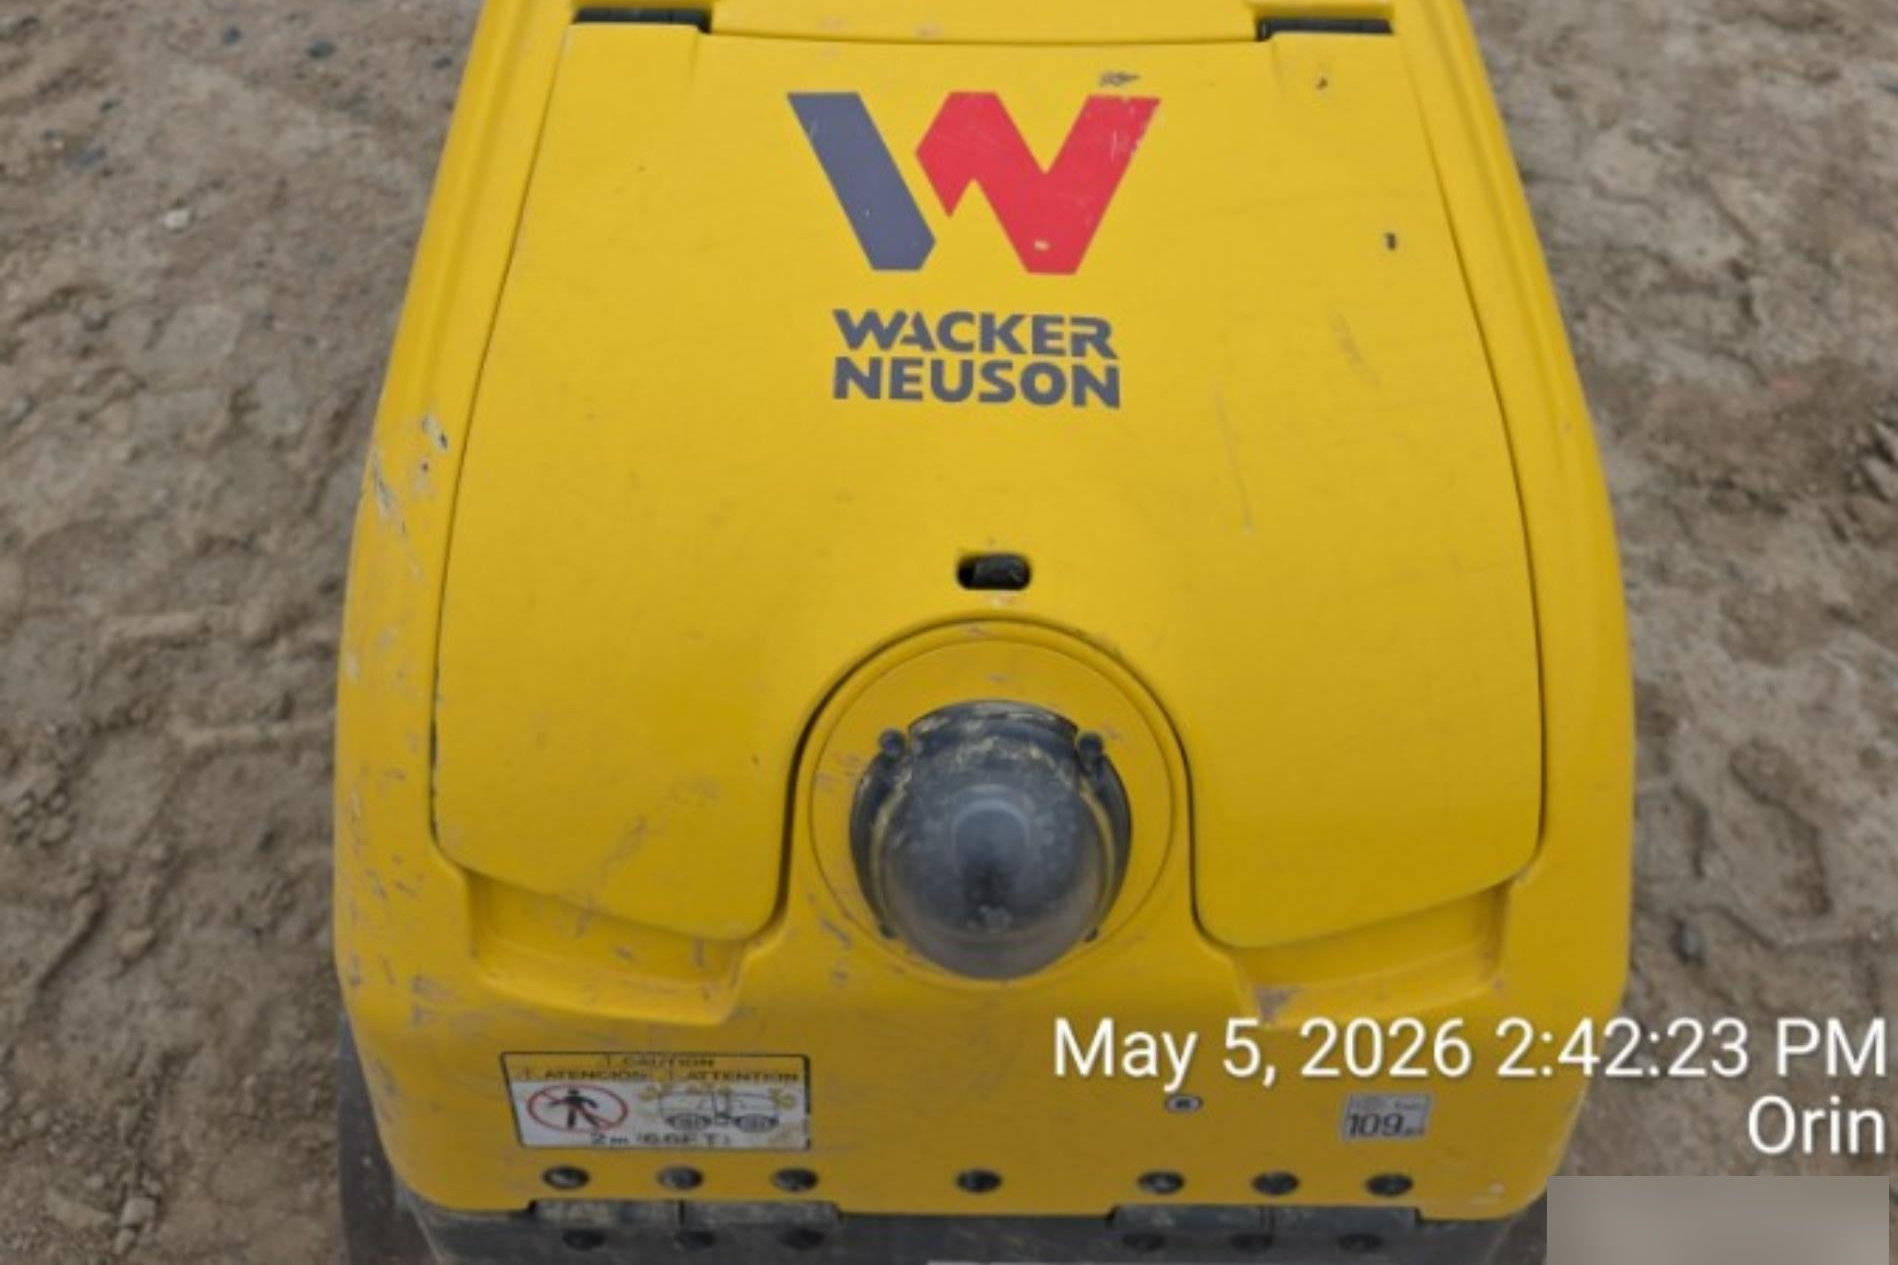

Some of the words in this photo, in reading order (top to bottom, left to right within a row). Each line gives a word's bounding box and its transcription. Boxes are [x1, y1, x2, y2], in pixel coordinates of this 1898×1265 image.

[833, 309, 1118, 360] WACKER
[833, 356, 1120, 409] NEUSON
[1349, 1112, 1405, 1137] 109
